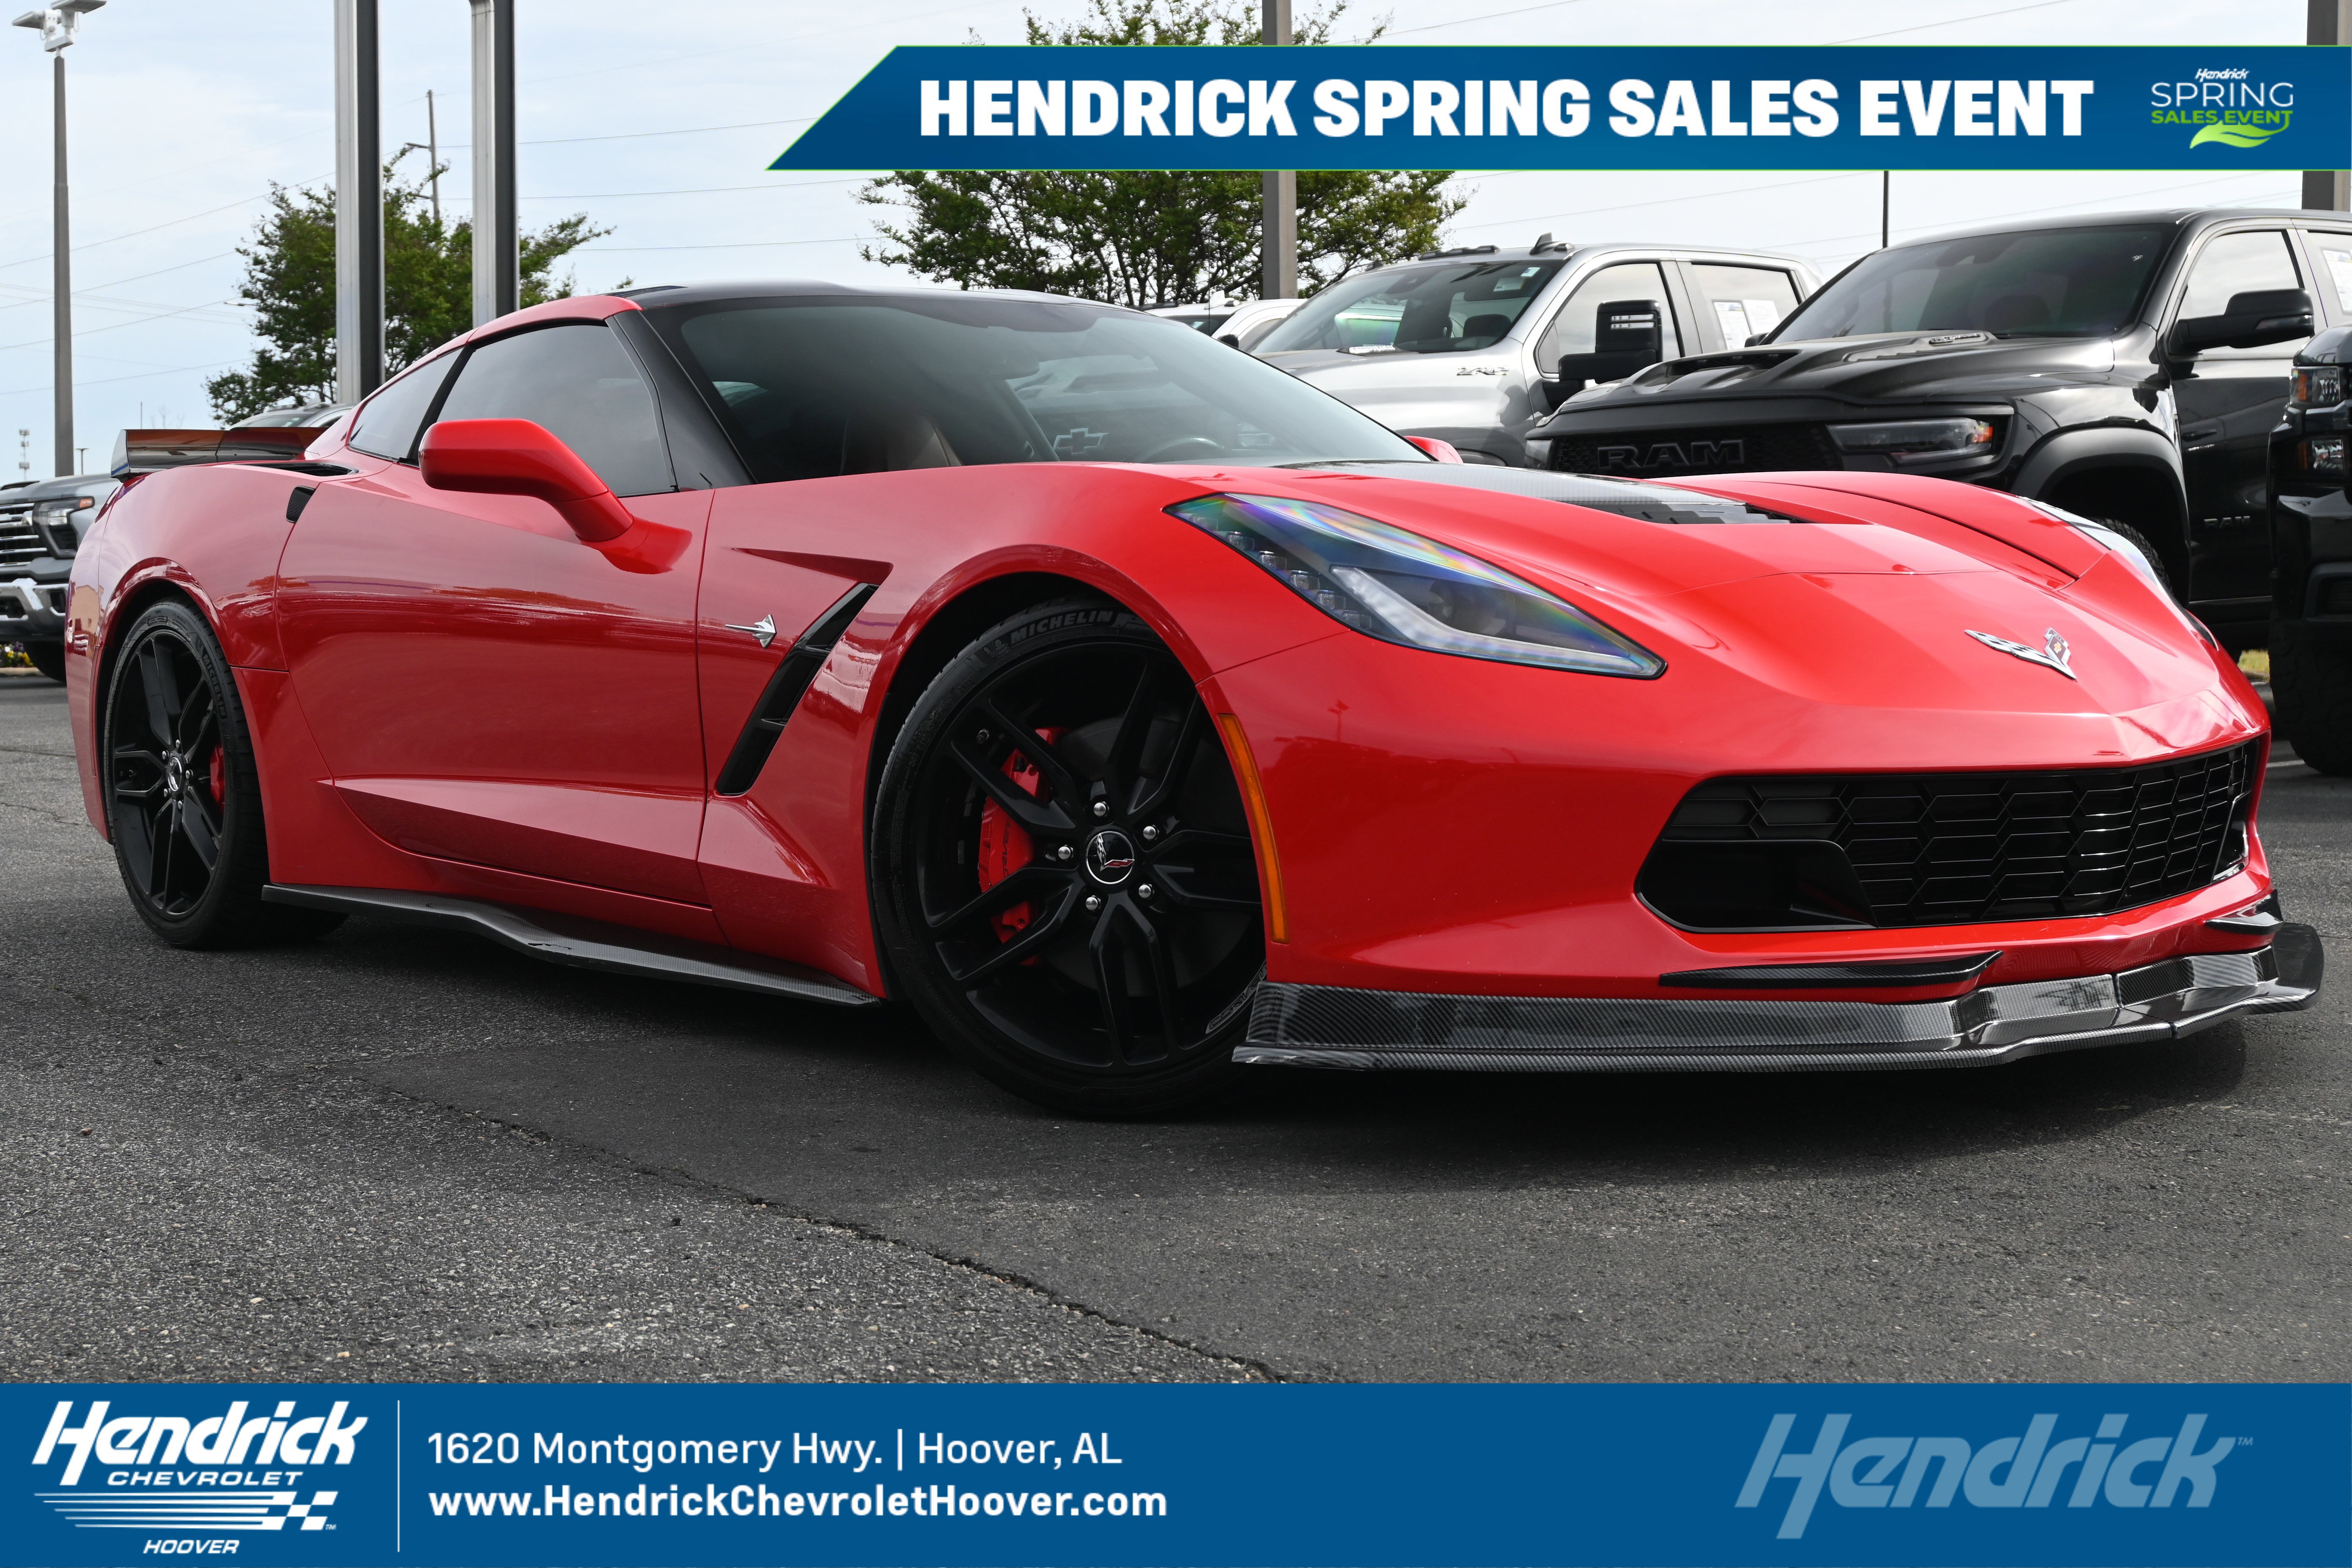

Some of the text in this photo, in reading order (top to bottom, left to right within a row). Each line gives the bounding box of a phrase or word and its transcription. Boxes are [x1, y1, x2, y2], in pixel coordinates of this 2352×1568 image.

[1598, 440, 1745, 470] RAM
[1010, 610, 1113, 645] MICHELIN
[203, 653, 227, 717] MICHELIN
